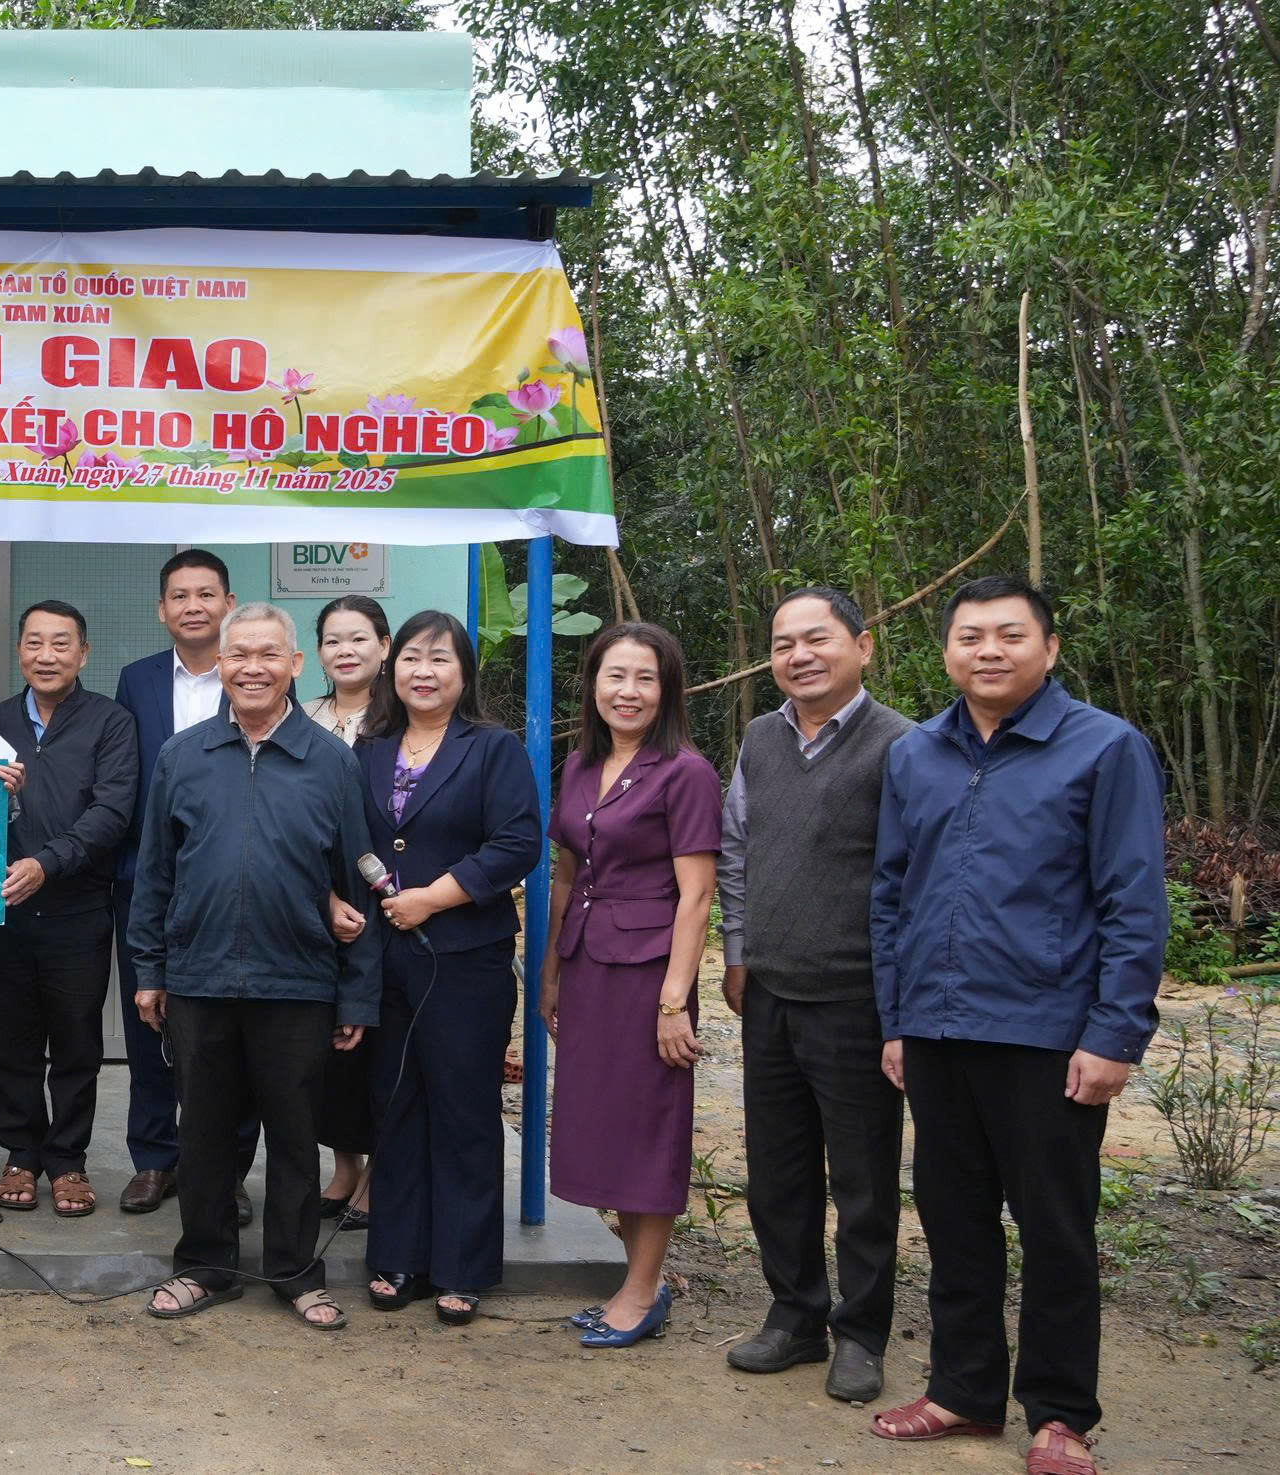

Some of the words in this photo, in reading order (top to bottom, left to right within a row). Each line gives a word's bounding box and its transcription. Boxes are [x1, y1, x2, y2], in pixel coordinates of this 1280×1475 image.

[39, 271, 66, 294] TỔ
[74, 272, 134, 296] QUỐC
[141, 276, 189, 299] VIỆT
[197, 280, 246, 298] NAM
[2, 304, 46, 322] TAM
[53, 304, 110, 324] XUÂN
[41, 335, 267, 392] GIAO
[83, 408, 192, 448] CHO
[213, 407, 285, 457] HỘ
[305, 409, 487, 454] NGHÈO
[3, 460, 66, 487] Xuân,
[73, 462, 132, 489] ngày
[132, 464, 163, 484] 27
[169, 466, 236, 492] tháng
[243, 467, 270, 489] 11
[275, 469, 329, 491] năm
[334, 469, 397, 491] 2025
[293, 544, 348, 565] BIDV
